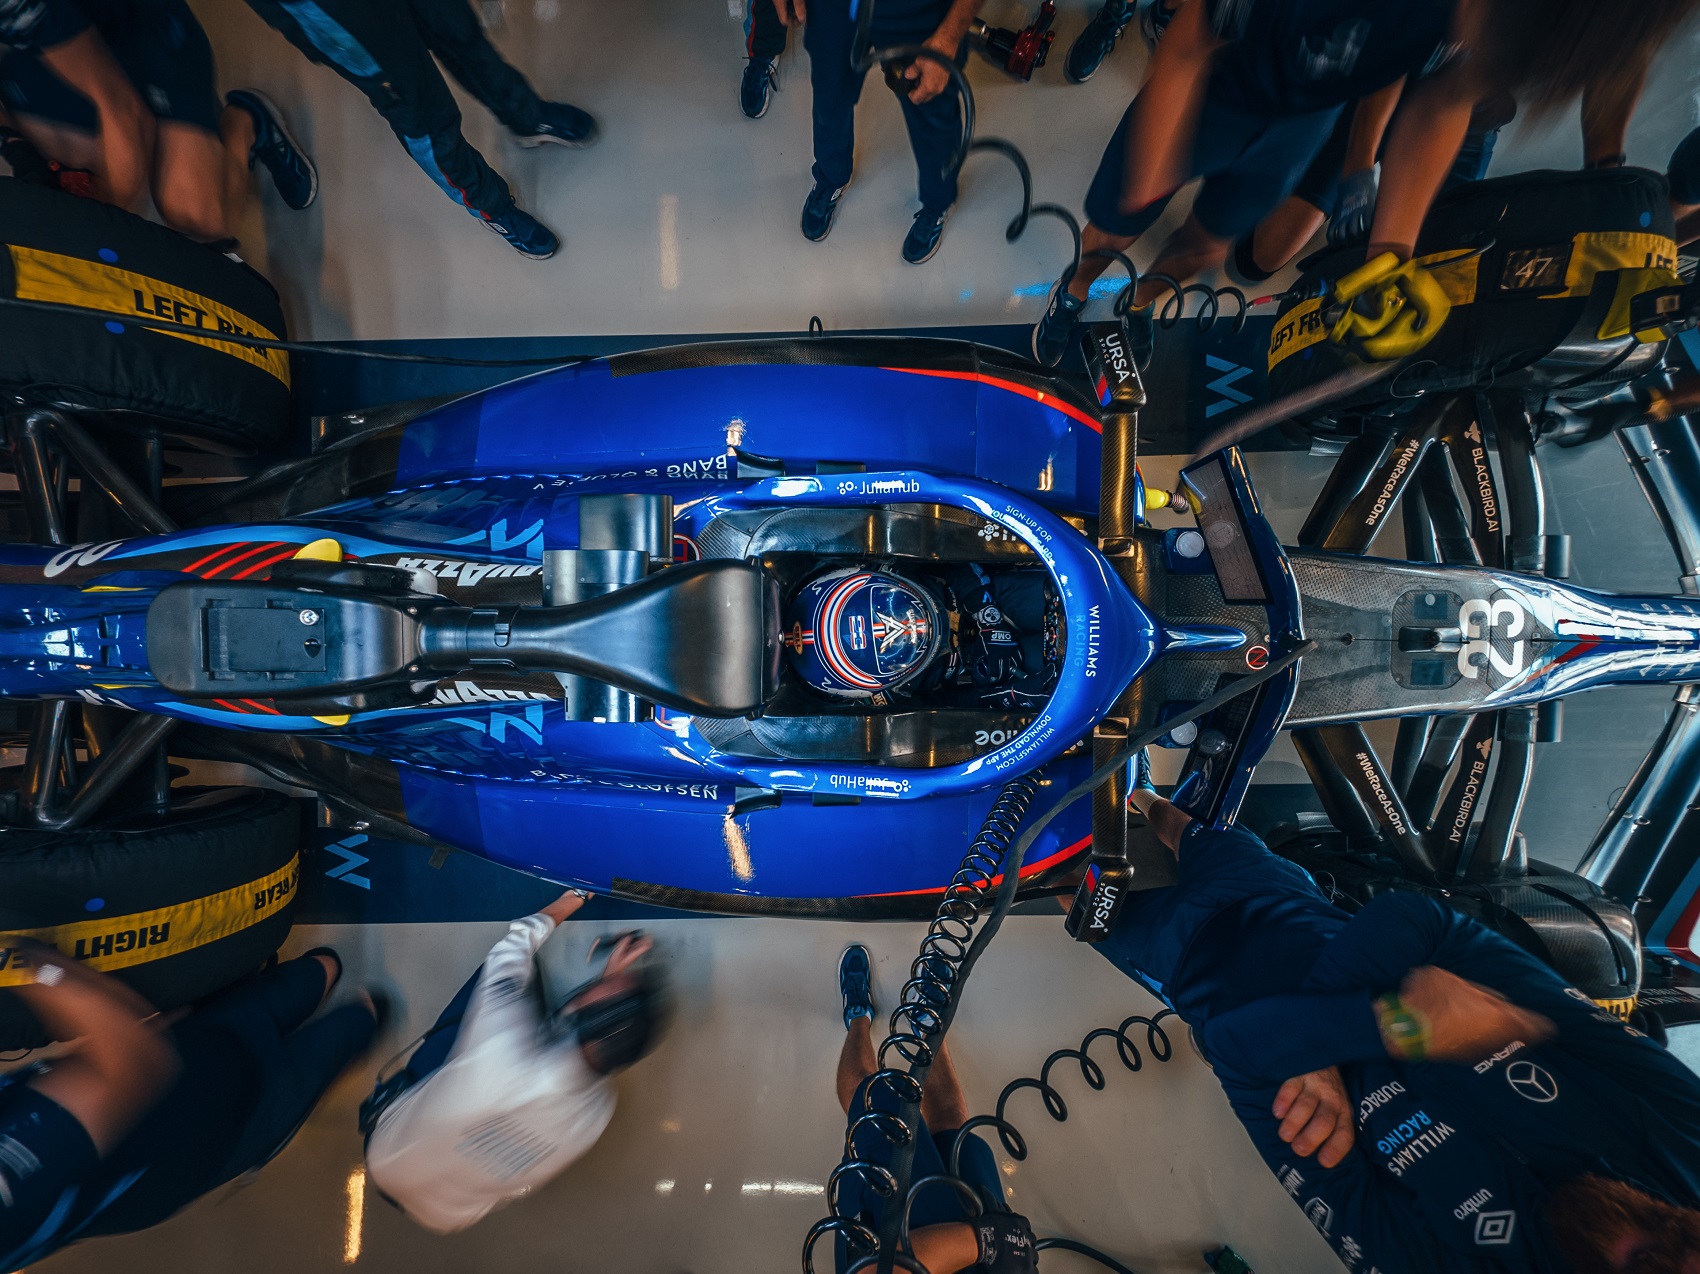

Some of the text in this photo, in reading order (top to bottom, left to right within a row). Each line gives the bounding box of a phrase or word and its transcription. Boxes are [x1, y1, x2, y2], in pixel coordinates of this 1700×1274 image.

[1515, 256, 1554, 278] 47
[133, 289, 208, 329] LEFT
[1105, 333, 1131, 384] URSA
[1270, 321, 1295, 355] LEFT
[666, 454, 728, 474] BANG
[1365, 439, 1420, 526] #WeRaceAsOne
[1472, 447, 1500, 532] BLACKBIRD.AI
[1005, 505, 1037, 529] SIGN-UP
[1035, 526, 1053, 543] FOR
[1073, 614, 1086, 667] RACING
[1085, 605, 1101, 677] WILLIAMS
[1457, 598, 1525, 679] 23
[1001, 747, 1016, 758] THE
[1015, 714, 1052, 749] DOWNLOAD
[1355, 752, 1406, 836] #WeRaceAsOne
[1449, 760, 1485, 843] BLACKBIRD.AI
[254, 877, 290, 910] REAR
[1089, 885, 1119, 929] URSA
[75, 921, 171, 961] RIGHT
[1377, 1110, 1432, 1155] RACING
[1387, 1121, 1456, 1177] WILLIAMS
[1453, 1187, 1494, 1220] umbro
